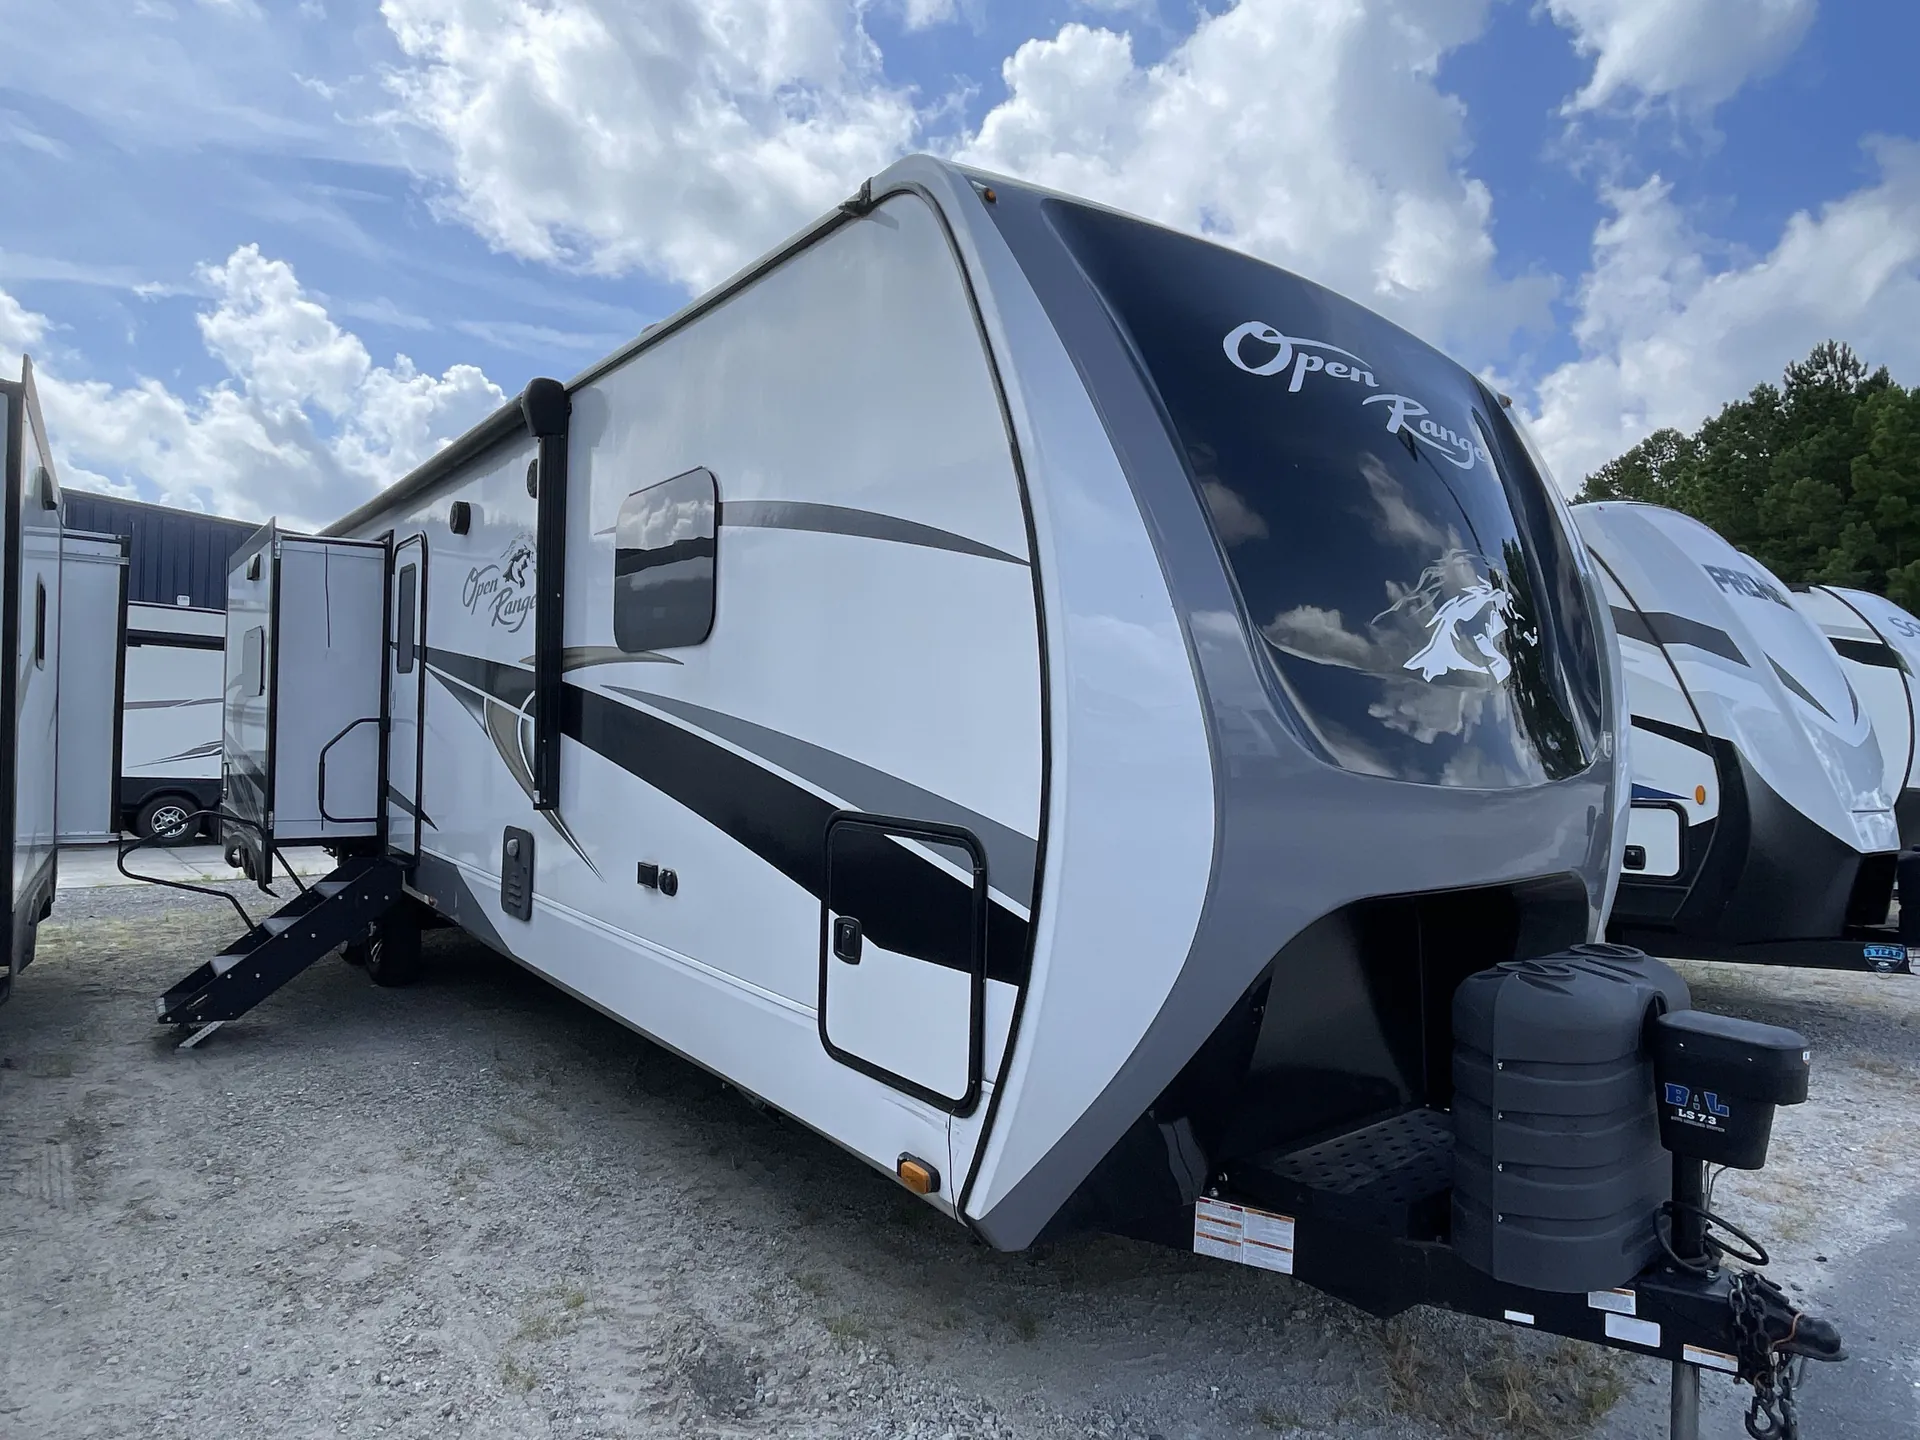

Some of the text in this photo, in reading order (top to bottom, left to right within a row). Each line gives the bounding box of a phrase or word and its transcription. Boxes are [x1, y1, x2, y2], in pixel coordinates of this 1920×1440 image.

[1223, 321, 1379, 392] Open
[1362, 394, 1487, 470] Range
[463, 564, 500, 615] Open
[1874, 949, 1902, 960] YEAR
[1678, 1108, 1695, 1120] LS
[1698, 1113, 1717, 1125] 73
